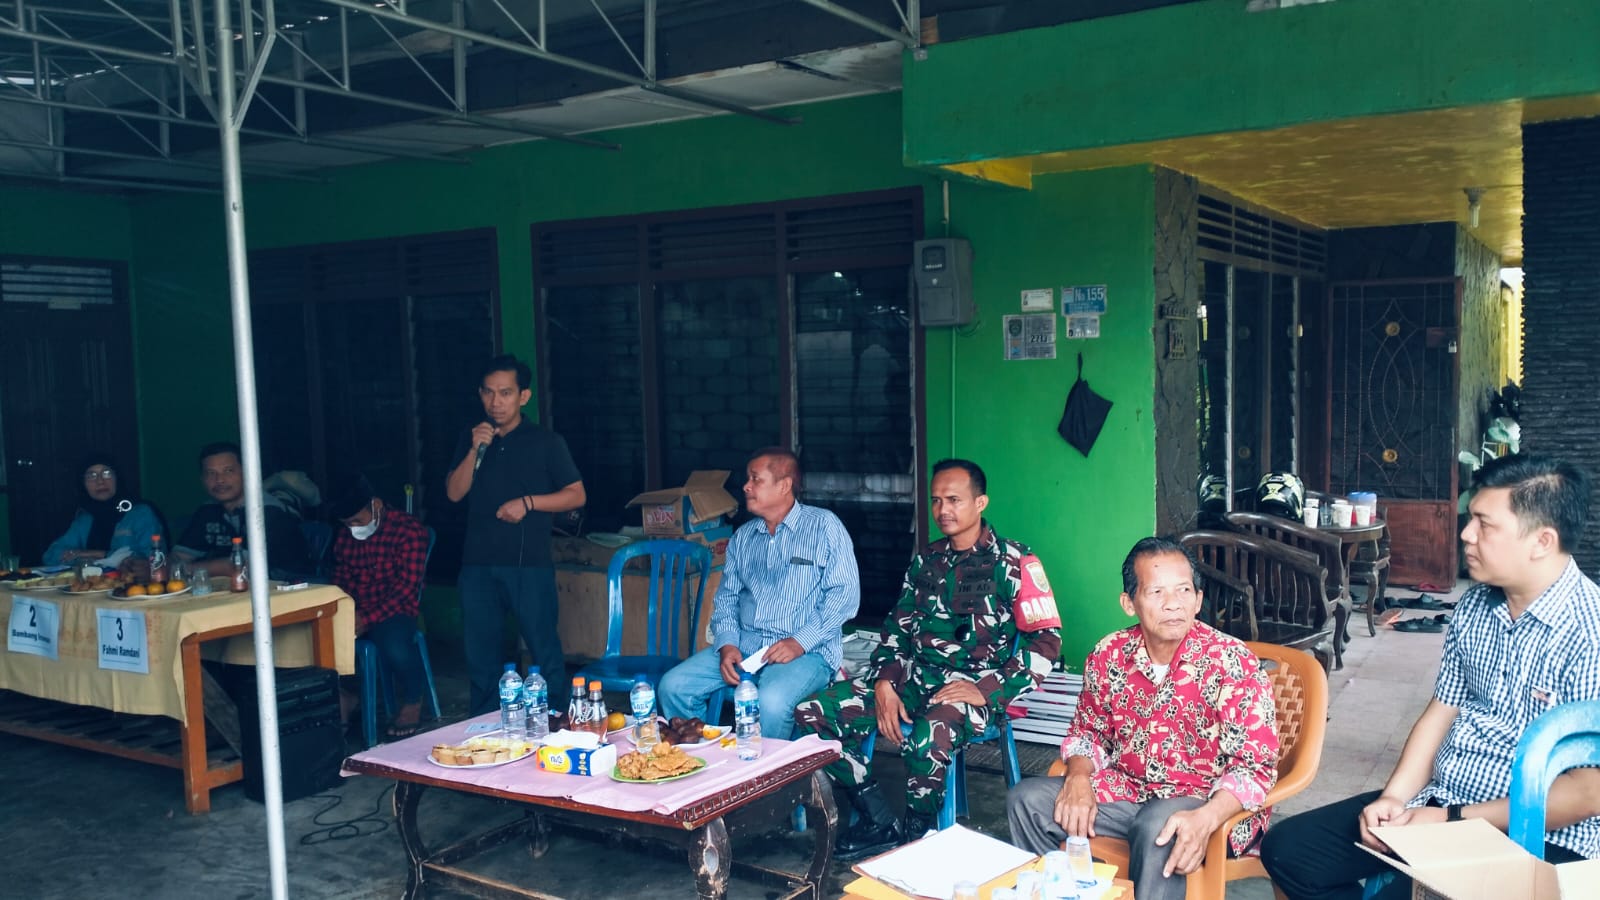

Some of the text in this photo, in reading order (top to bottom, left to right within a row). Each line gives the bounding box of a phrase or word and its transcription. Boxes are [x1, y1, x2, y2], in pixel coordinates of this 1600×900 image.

[1087, 287, 1104, 301] 155
[29, 605, 37, 627] 2
[116, 617, 124, 641] 3
[102, 644, 119, 656] Fahmi
